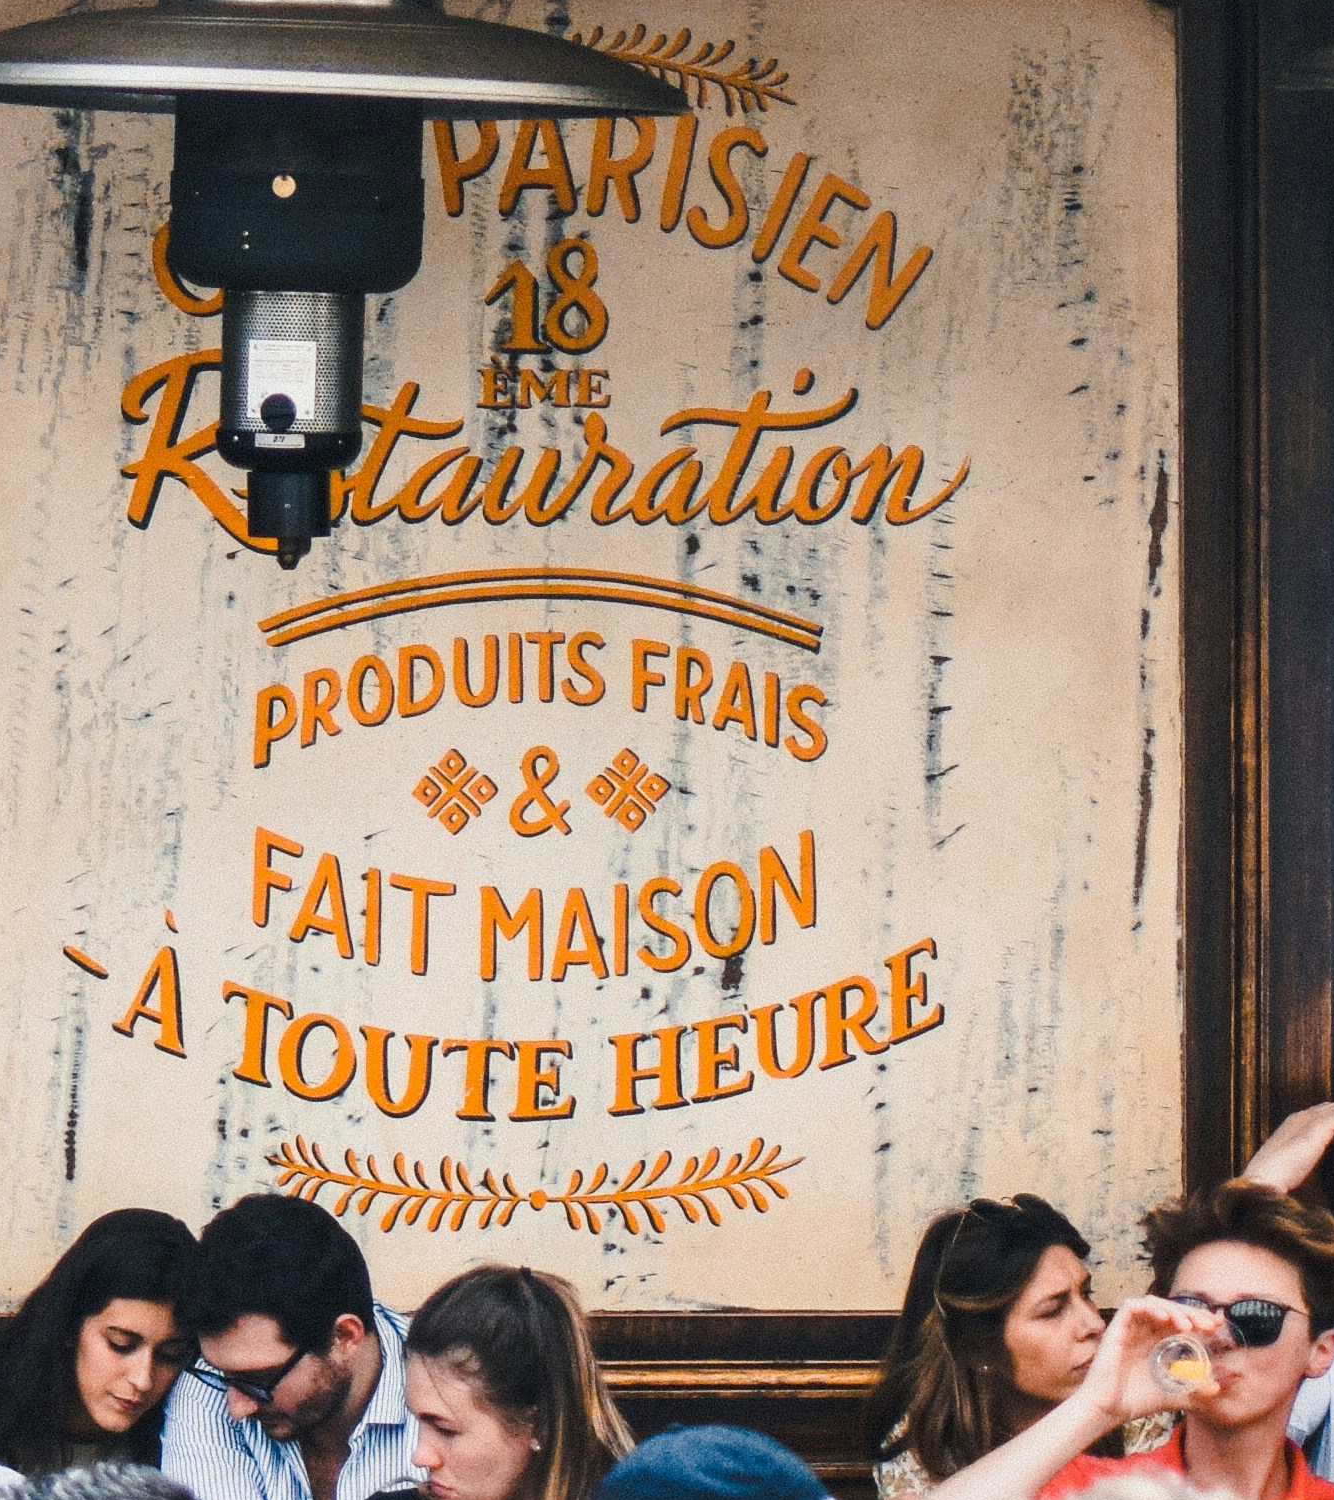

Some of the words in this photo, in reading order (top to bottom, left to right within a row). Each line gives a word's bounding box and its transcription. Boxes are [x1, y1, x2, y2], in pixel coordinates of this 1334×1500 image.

[431, 114, 934, 331] PARISIEN
[484, 237, 609, 356] 18
[119, 347, 970, 557] Rtauration
[252, 630, 607, 769] PRODUITS
[630, 638, 831, 763] FRAIS
[507, 744, 574, 838] &
[251, 824, 458, 977] FAIT
[477, 828, 820, 984] MAISON
[221, 979, 576, 1123] TOUTE
[608, 936, 946, 1117] HEURE
